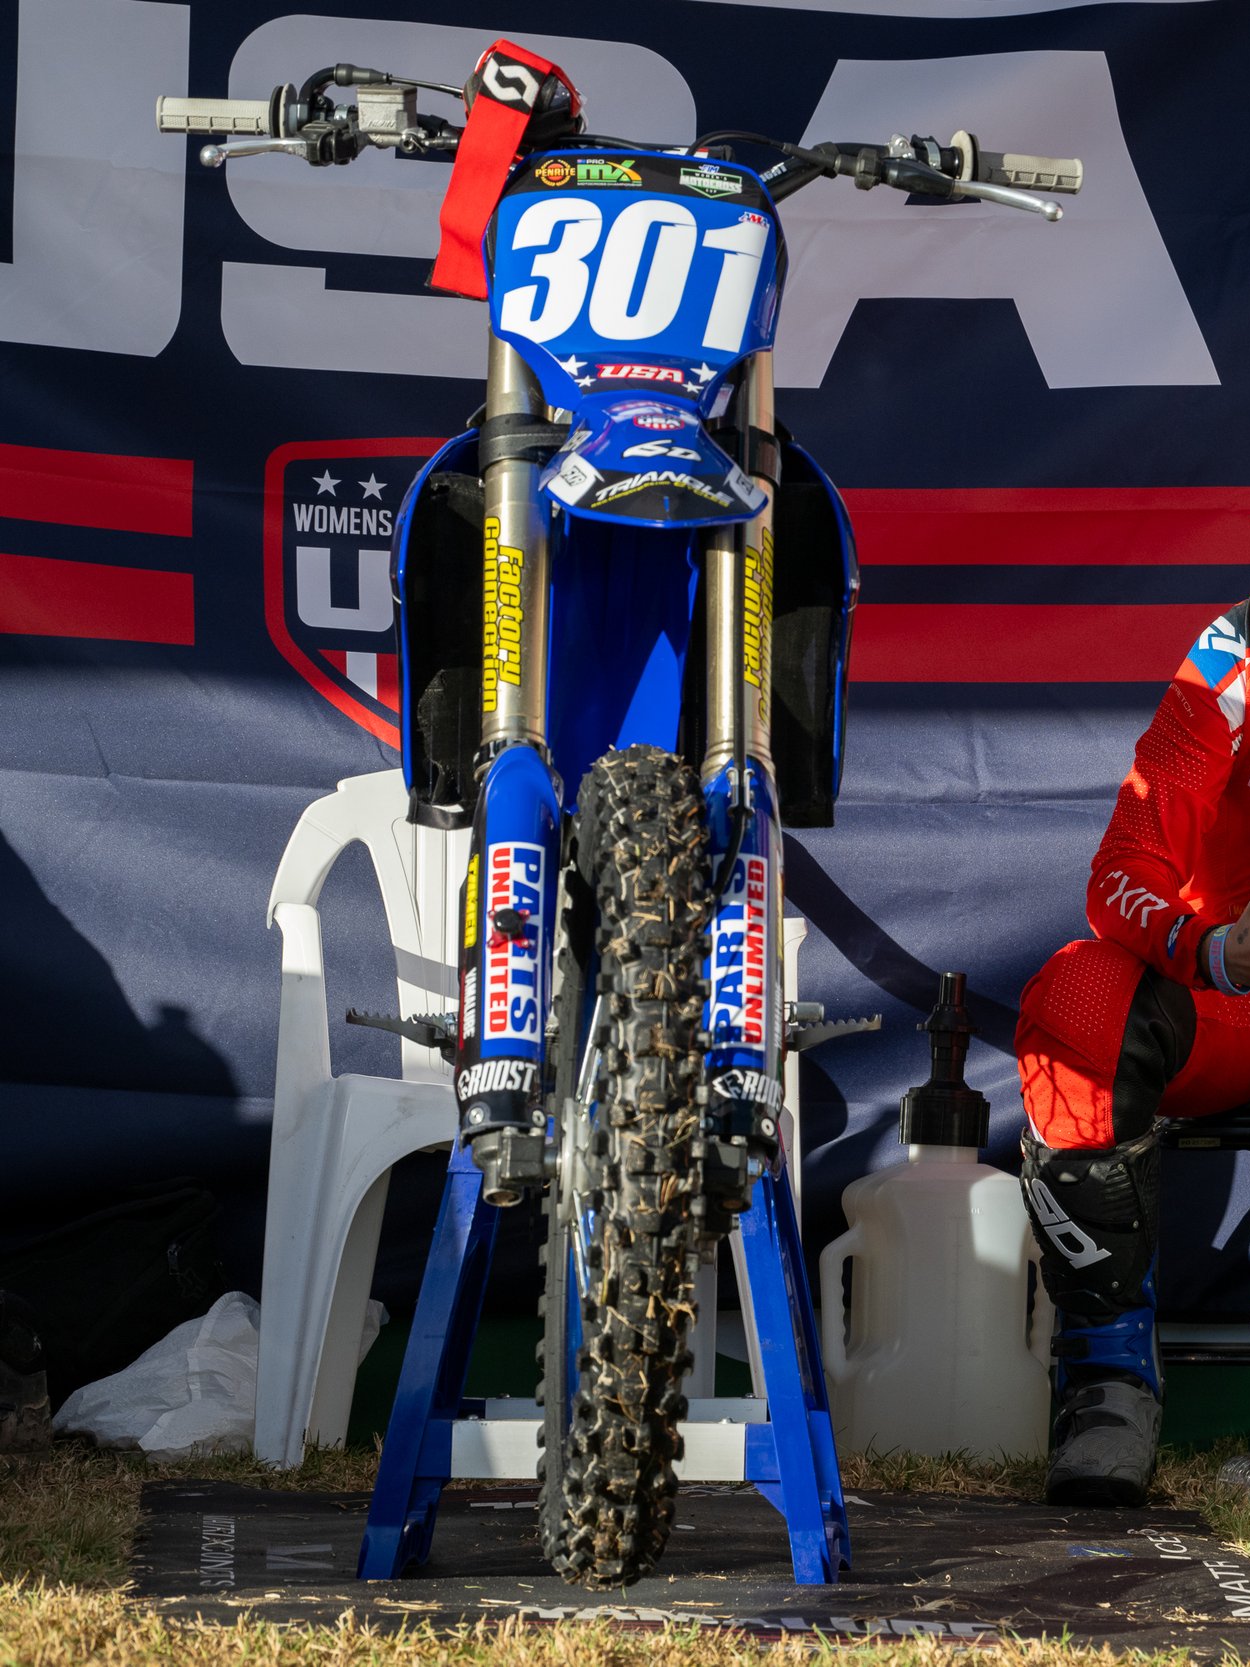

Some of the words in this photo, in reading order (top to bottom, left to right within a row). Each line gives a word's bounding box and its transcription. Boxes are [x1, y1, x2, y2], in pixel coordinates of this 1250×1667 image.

[535, 167, 576, 177] PENRITE
[680, 175, 742, 193] MOTOCROSS
[759, 162, 787, 182] IGHT
[738, 211, 769, 228] AMA
[500, 197, 769, 353] 301
[598, 364, 684, 383] USA
[595, 470, 735, 504] TRIANGLE
[293, 503, 392, 536] WOMENS
[483, 516, 501, 713] Connection
[500, 544, 524, 687] Factory
[489, 847, 511, 1033] UNLITED
[509, 847, 541, 1036] PARTS
[744, 859, 765, 1044] UNLIMITED
[463, 966, 478, 1041] YAMALUBE
[466, 1059, 537, 1097] ROOST
[741, 1070, 784, 1110] ROOS
